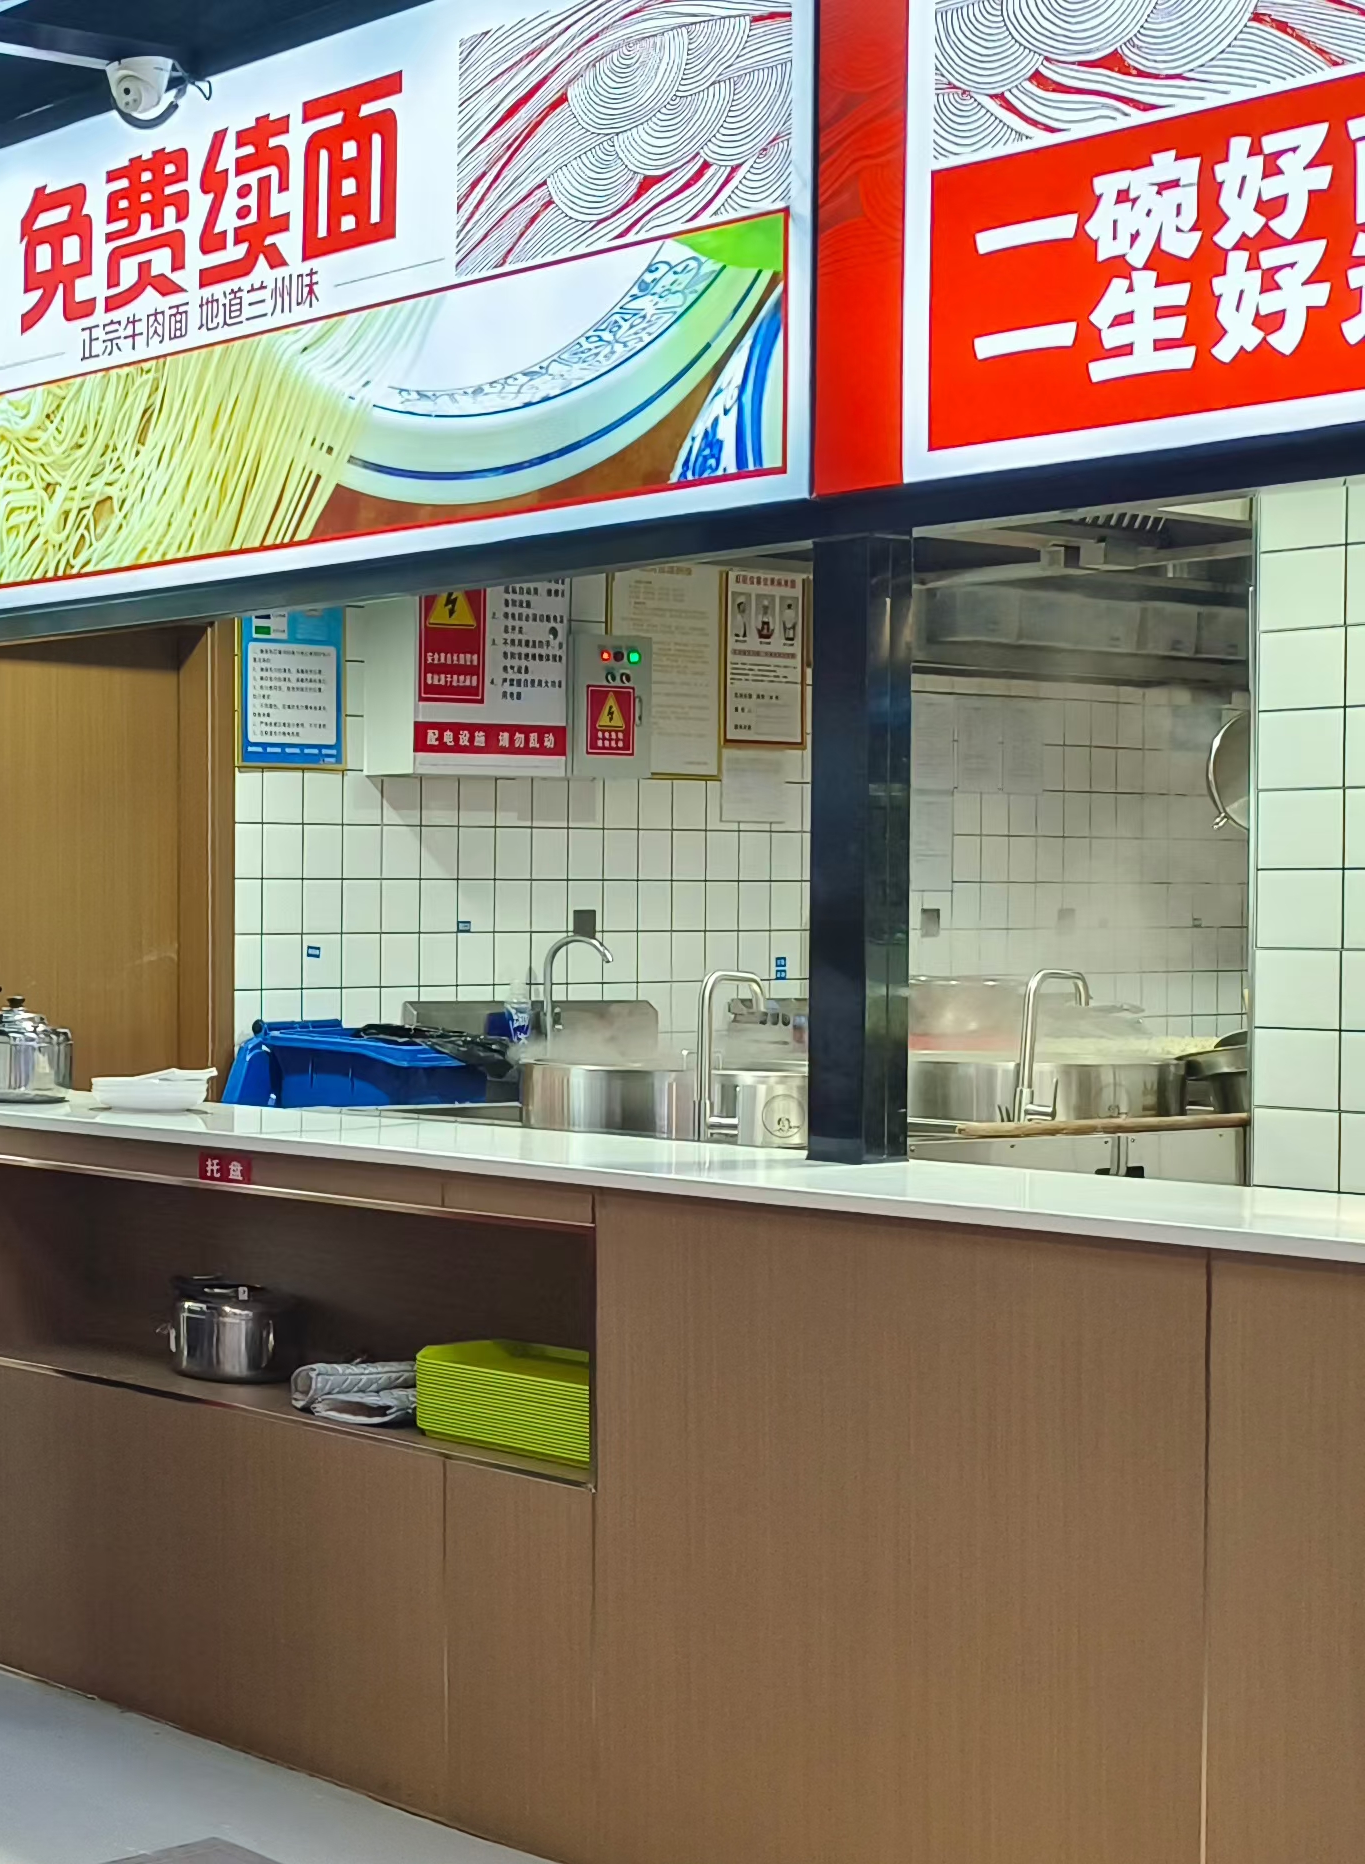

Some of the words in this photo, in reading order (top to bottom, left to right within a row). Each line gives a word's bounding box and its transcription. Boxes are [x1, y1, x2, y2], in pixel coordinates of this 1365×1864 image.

[20, 70, 403, 335] 免费续面
[974, 116, 1365, 269] 一碗好
[80, 308, 189, 362] 正宗牛肉面
[199, 268, 320, 334] 地道兰州味
[973, 232, 1365, 384] 一生好
[427, 729, 486, 747] 配电设施
[498, 731, 555, 748] 请勿乱动
[206, 1158, 243, 1180] 托盘
